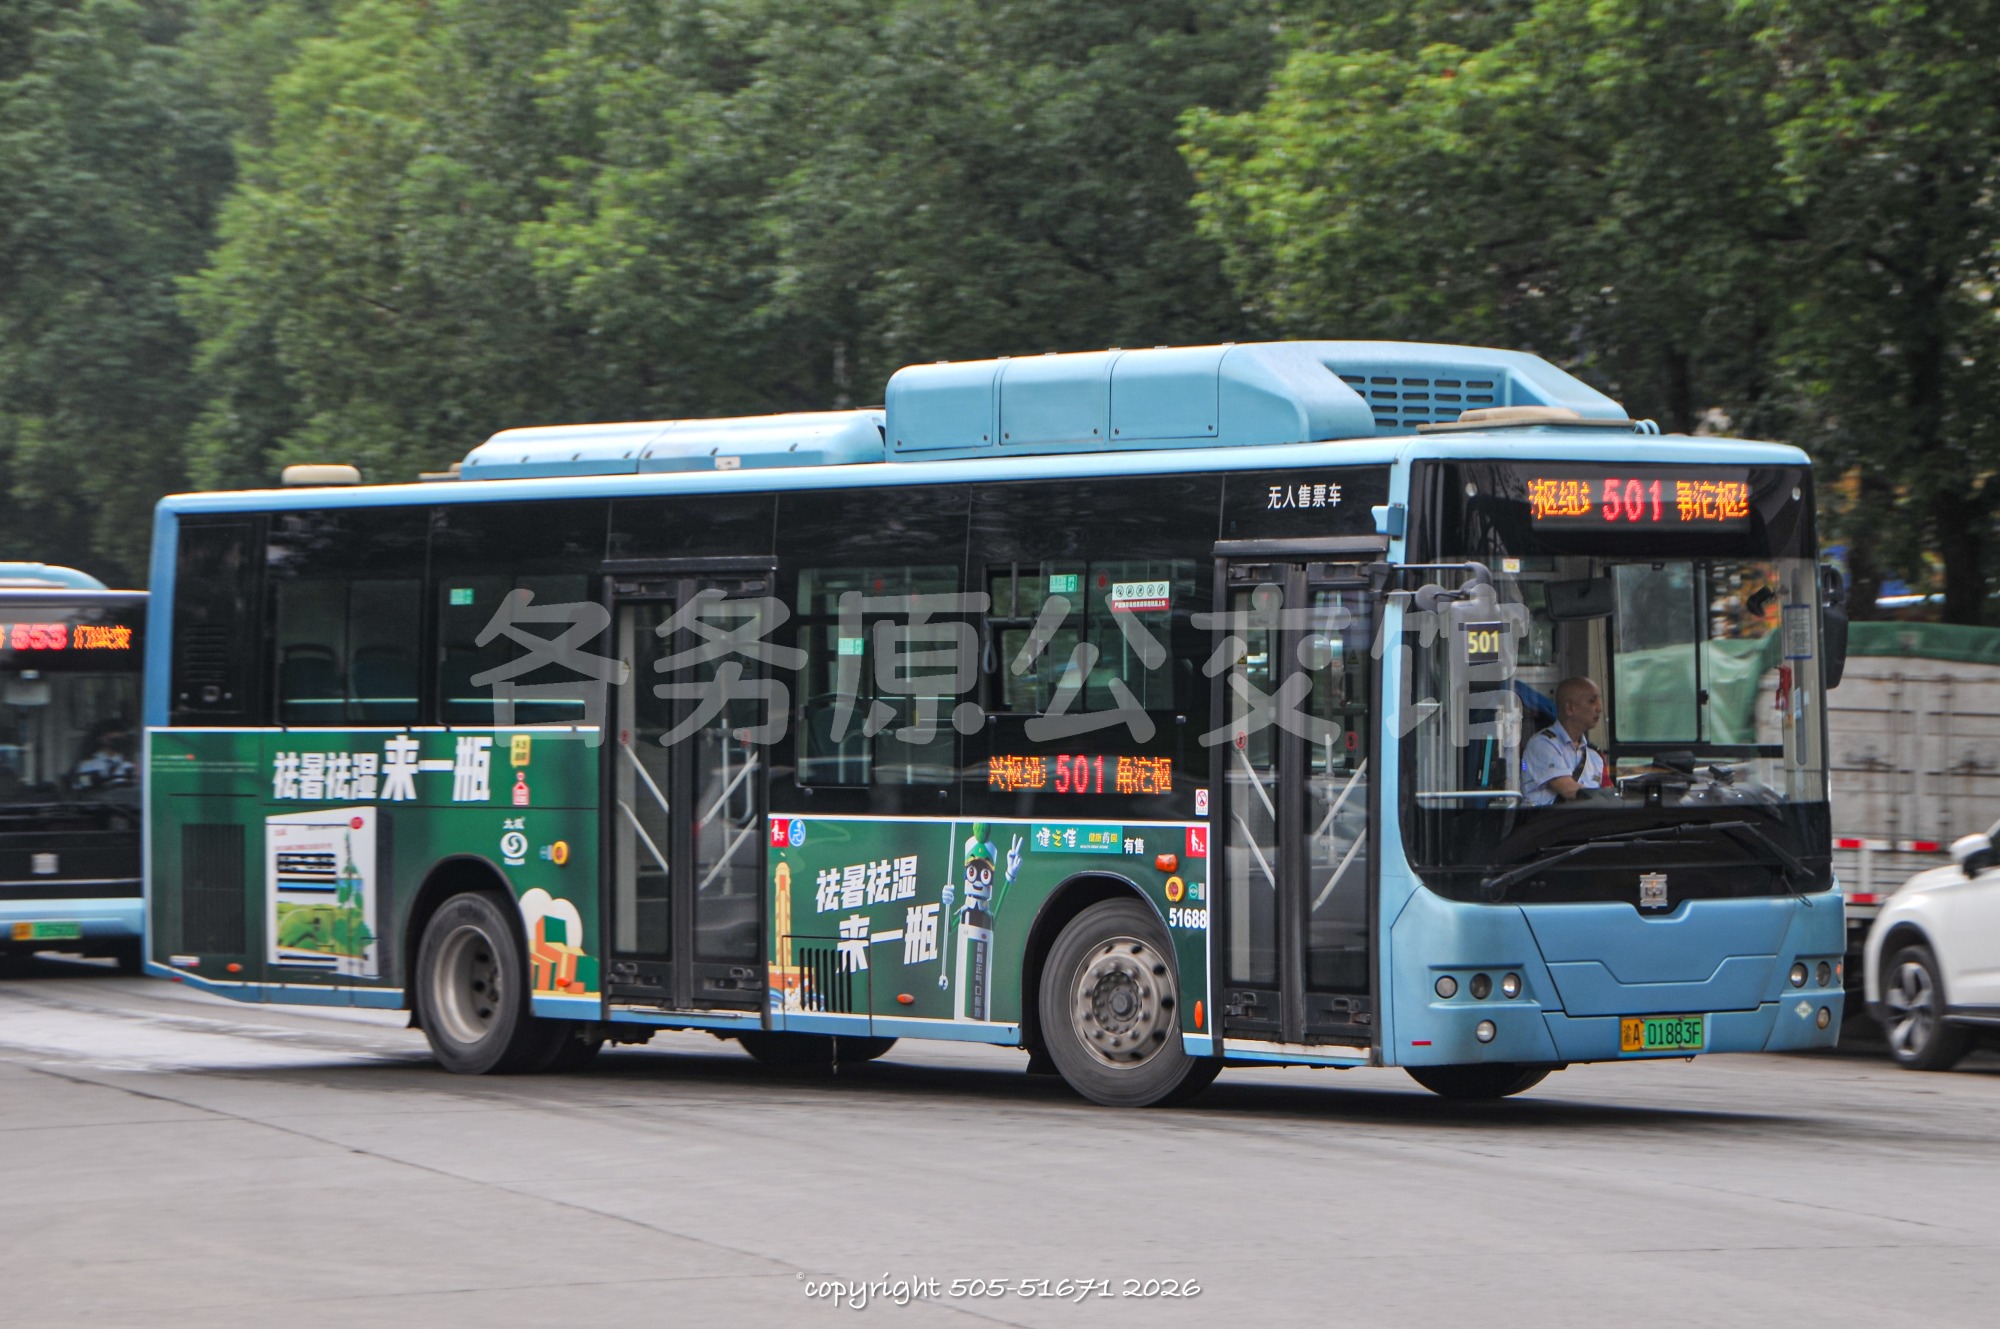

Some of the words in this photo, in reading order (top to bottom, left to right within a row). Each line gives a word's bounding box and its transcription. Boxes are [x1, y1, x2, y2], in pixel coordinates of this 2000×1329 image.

[1267, 483, 1342, 509] 无人售票车
[1528, 479, 1590, 519] 枢纽
[1602, 479, 1662, 521] 501
[1468, 630, 1499, 653] 501
[989, 755, 1046, 791] 兴枢纽
[1055, 755, 1104, 793] 501
[1123, 838, 1144, 855] 有售
[815, 855, 918, 914] 祛暑祛湿
[1169, 907, 1207, 930] 51688
[835, 903, 940, 974] 来一瓶
